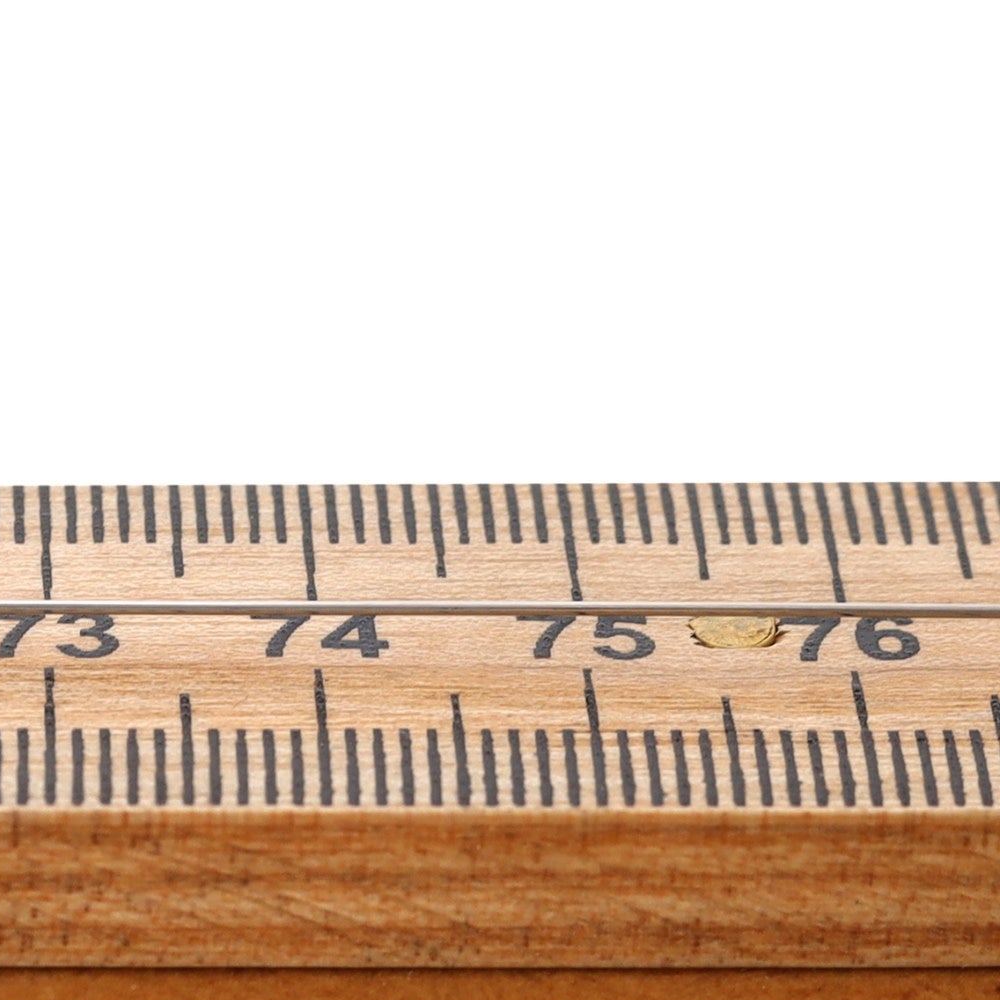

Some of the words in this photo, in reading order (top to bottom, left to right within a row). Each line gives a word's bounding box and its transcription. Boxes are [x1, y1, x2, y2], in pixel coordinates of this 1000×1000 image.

[250, 613, 389, 658] 74
[516, 614, 656, 660] 75
[779, 615, 921, 661] 76
